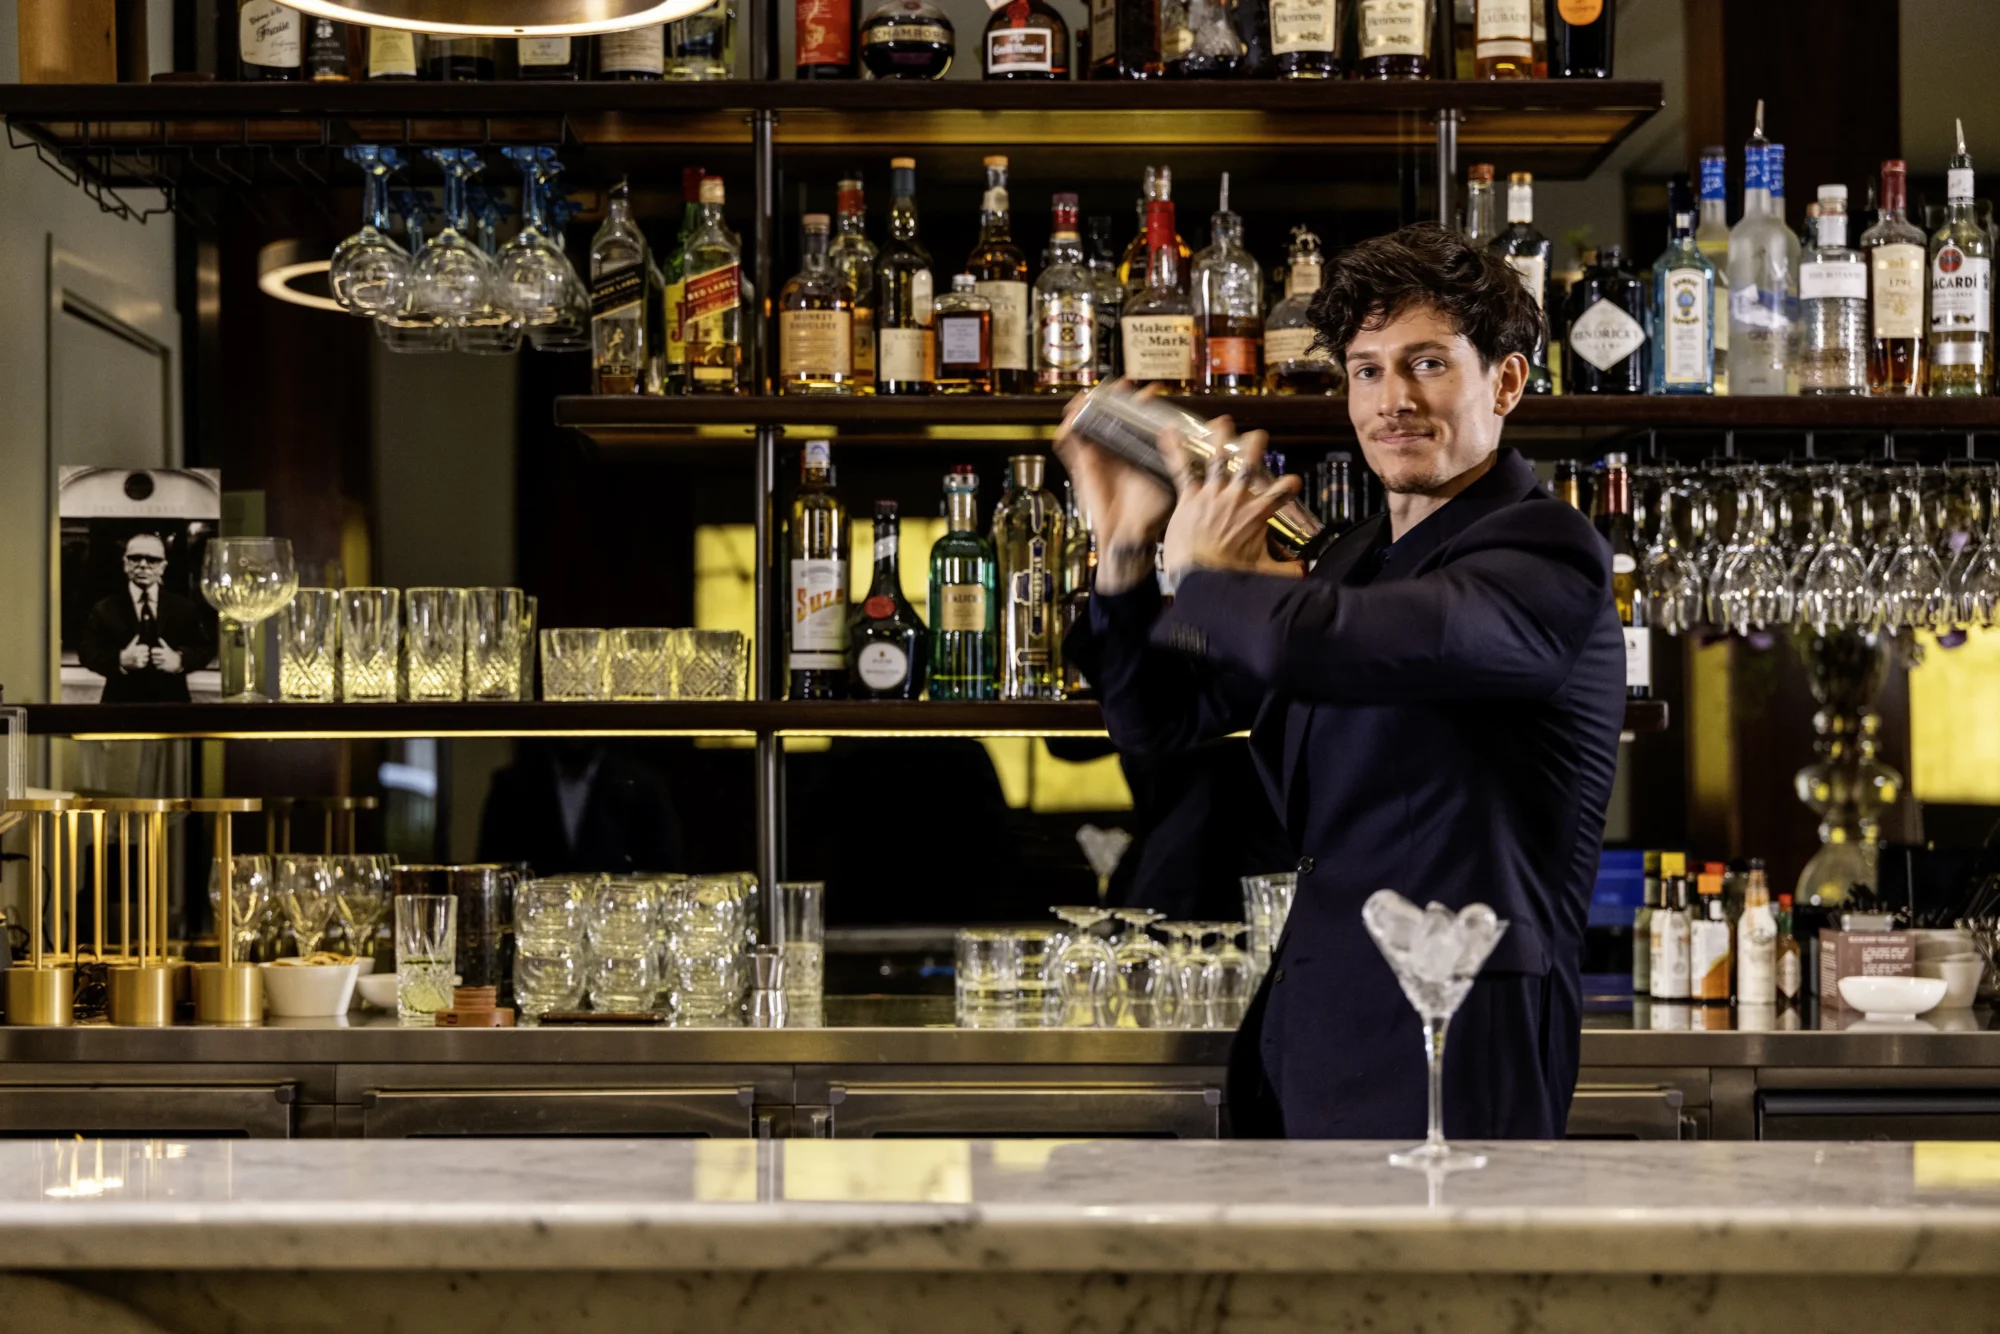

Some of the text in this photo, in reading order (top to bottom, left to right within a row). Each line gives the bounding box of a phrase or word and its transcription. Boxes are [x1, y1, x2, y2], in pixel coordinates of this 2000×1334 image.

[1278, 13, 1322, 23] Hennessy
[1368, 17, 1413, 26] Hennessy
[687, 288, 707, 301] RED
[707, 278, 738, 294] LABEL
[1131, 323, 1190, 333] Maker's
